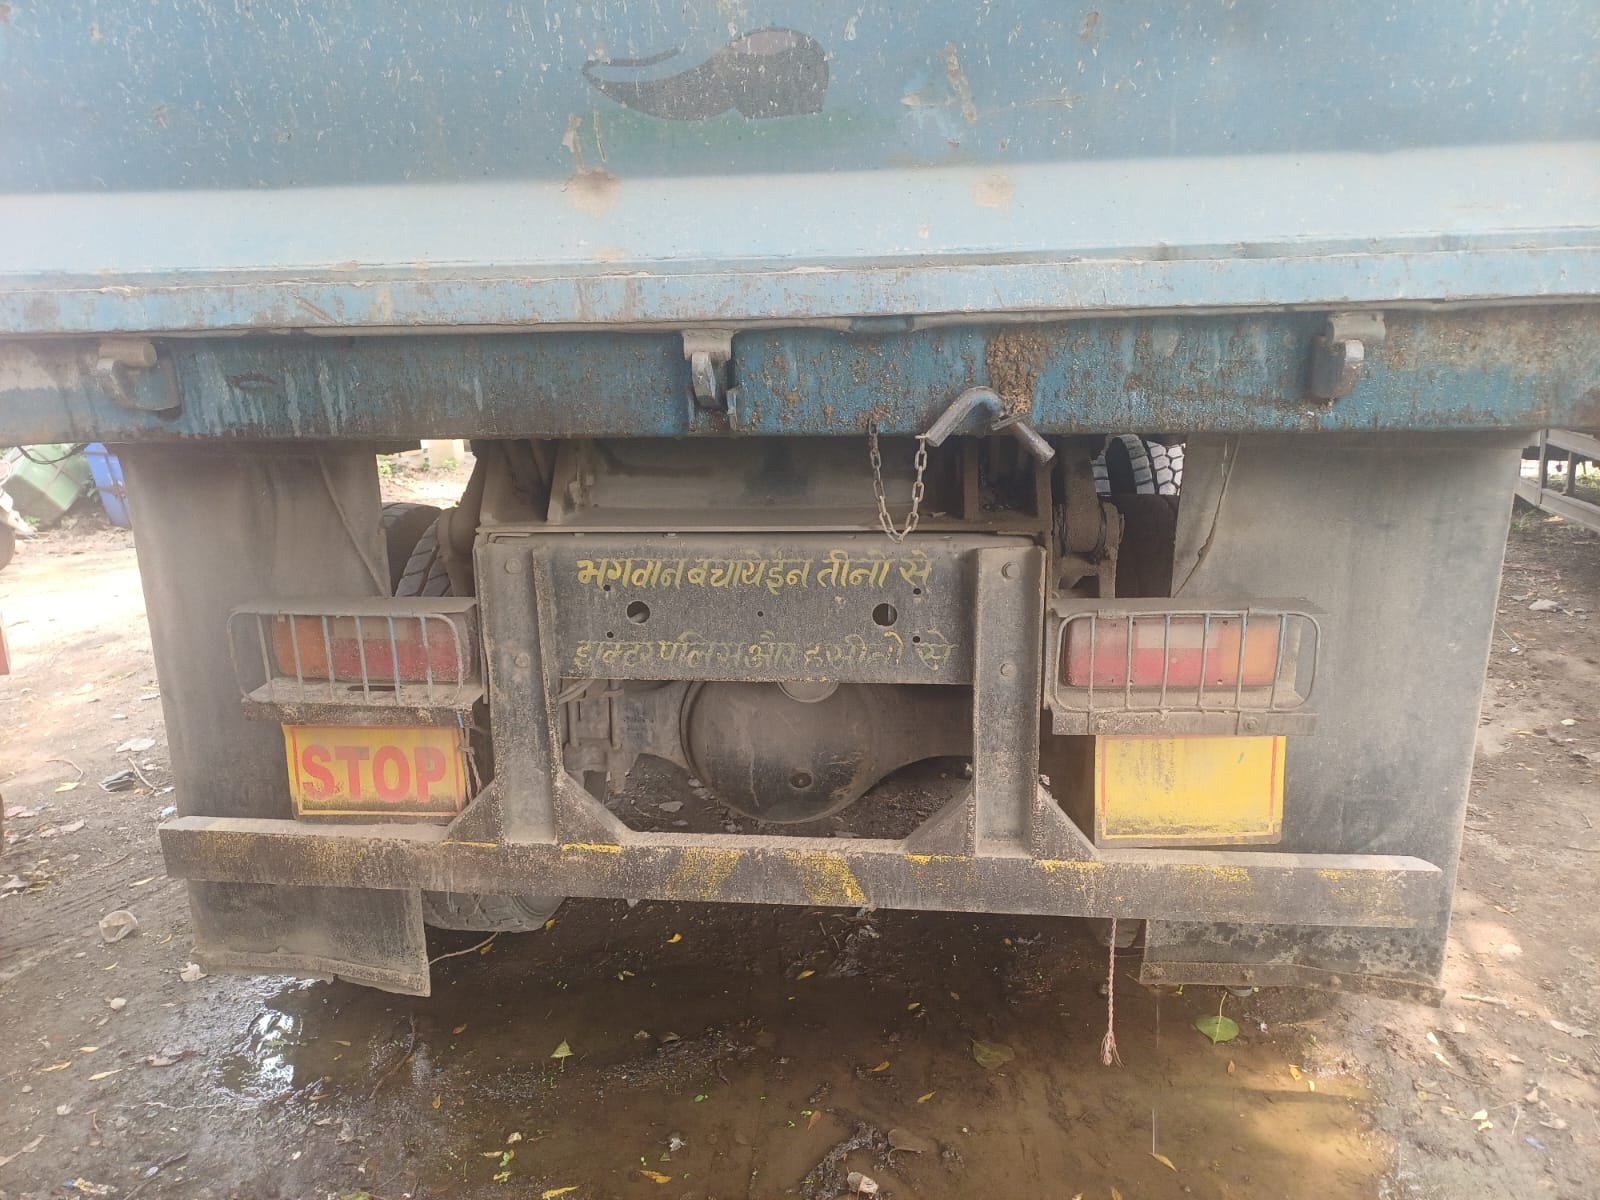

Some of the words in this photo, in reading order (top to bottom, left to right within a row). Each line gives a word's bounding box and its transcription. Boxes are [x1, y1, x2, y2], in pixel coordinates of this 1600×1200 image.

[574, 558, 685, 588] भगवान
[899, 550, 937, 590] से
[301, 745, 446, 803] STOP
